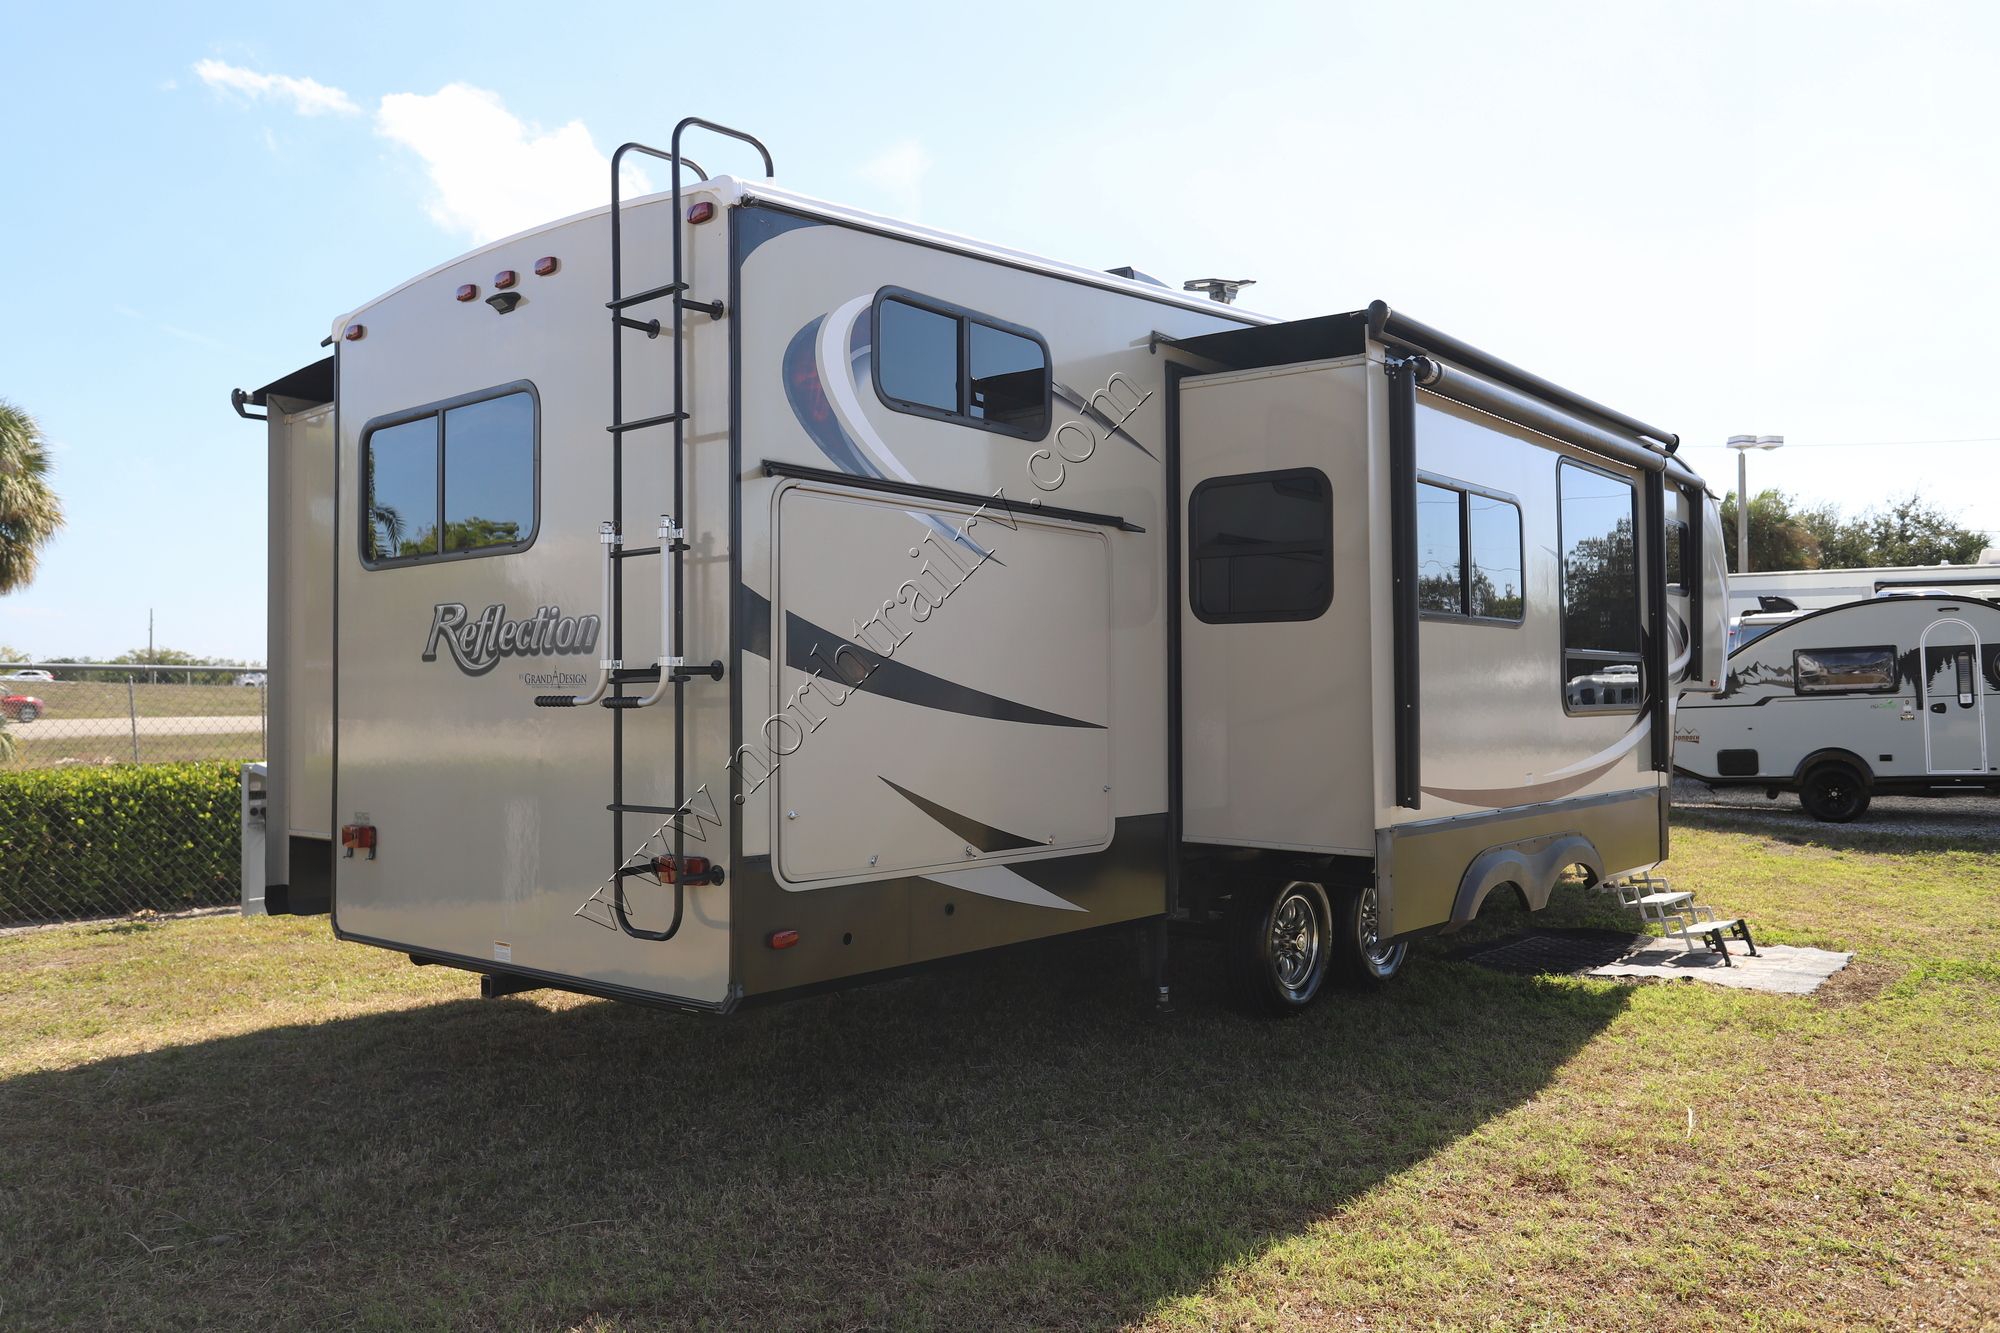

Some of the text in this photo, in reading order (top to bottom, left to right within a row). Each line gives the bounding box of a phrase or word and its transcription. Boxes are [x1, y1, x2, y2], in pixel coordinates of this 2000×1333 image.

[422, 603, 601, 677] Reflection
[524, 672, 552, 684] GRAND
[559, 672, 587, 684] DESIGN
